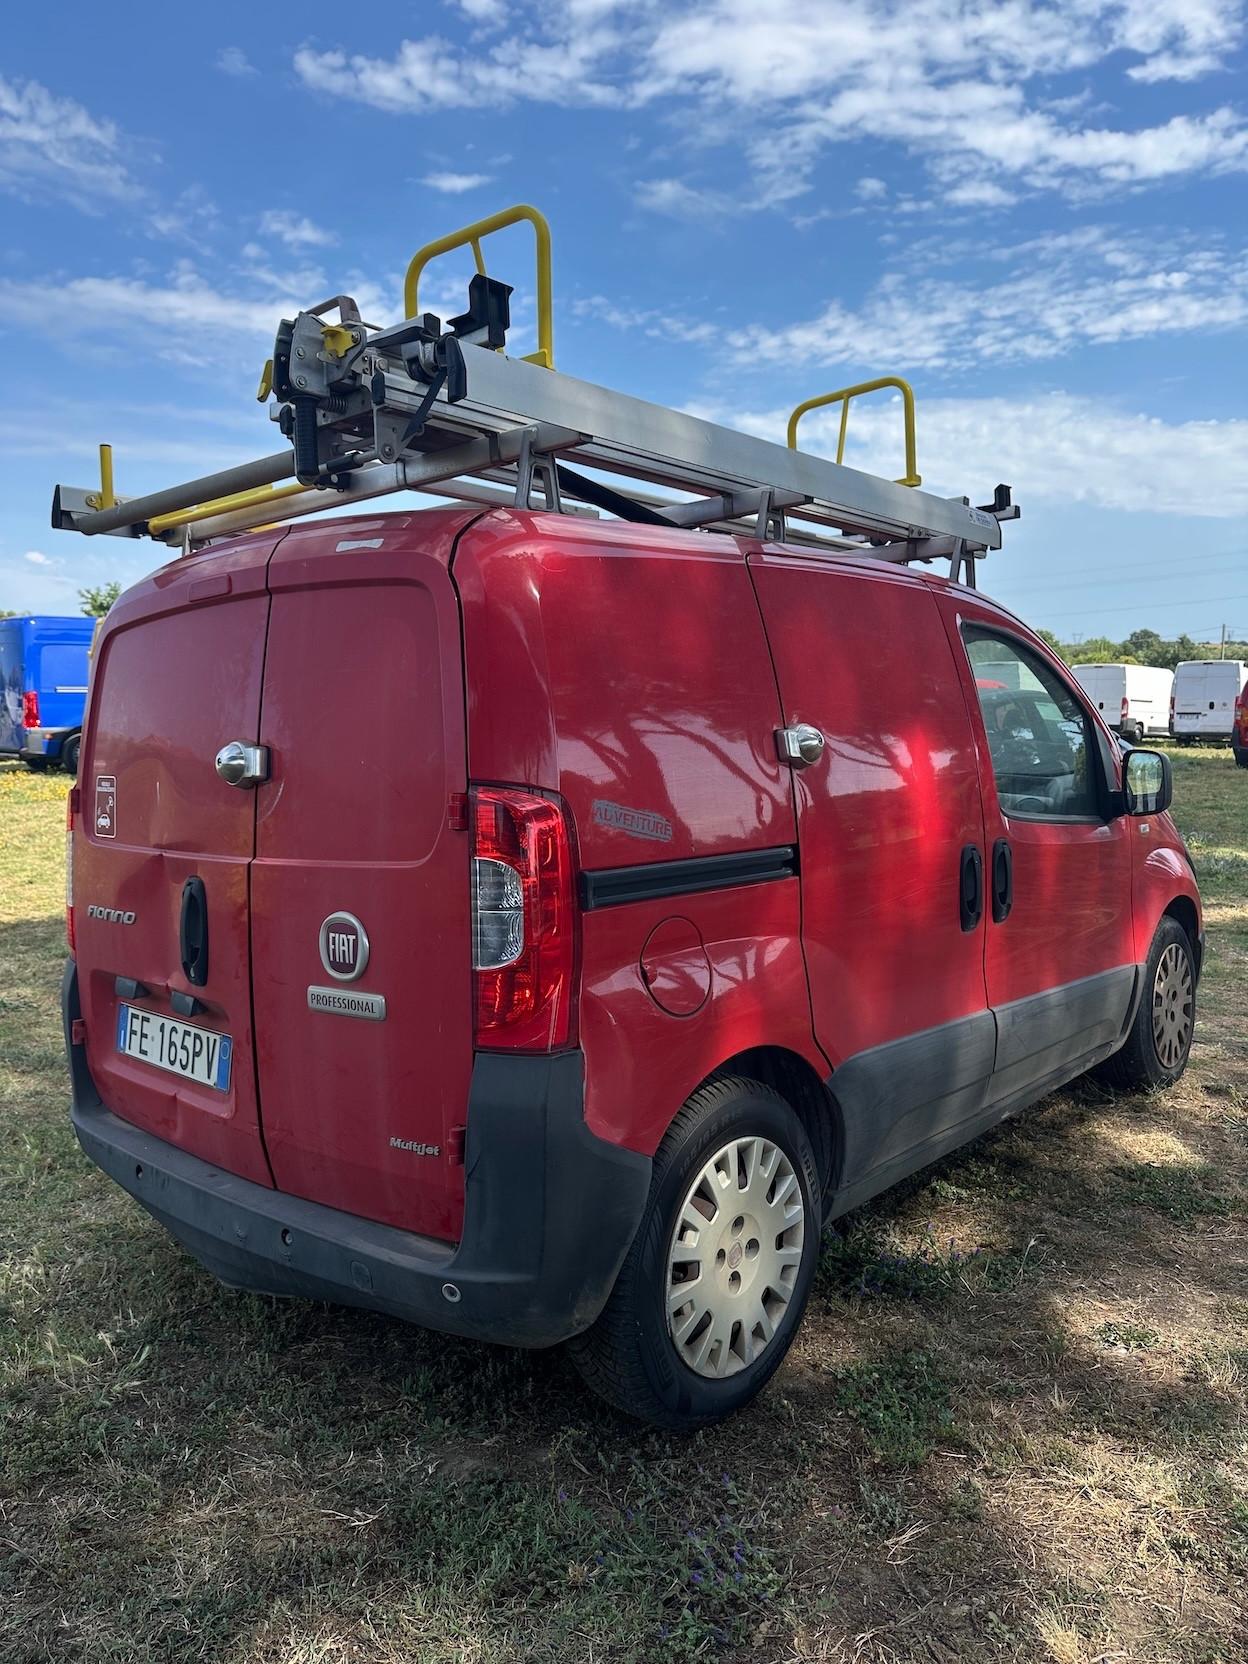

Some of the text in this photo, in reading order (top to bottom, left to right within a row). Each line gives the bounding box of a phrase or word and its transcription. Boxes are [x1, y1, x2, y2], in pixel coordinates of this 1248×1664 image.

[328, 932, 356, 964] FIAT
[310, 993, 377, 1014] PROFESSIONAL
[128, 1012, 217, 1080] FE 165PV
